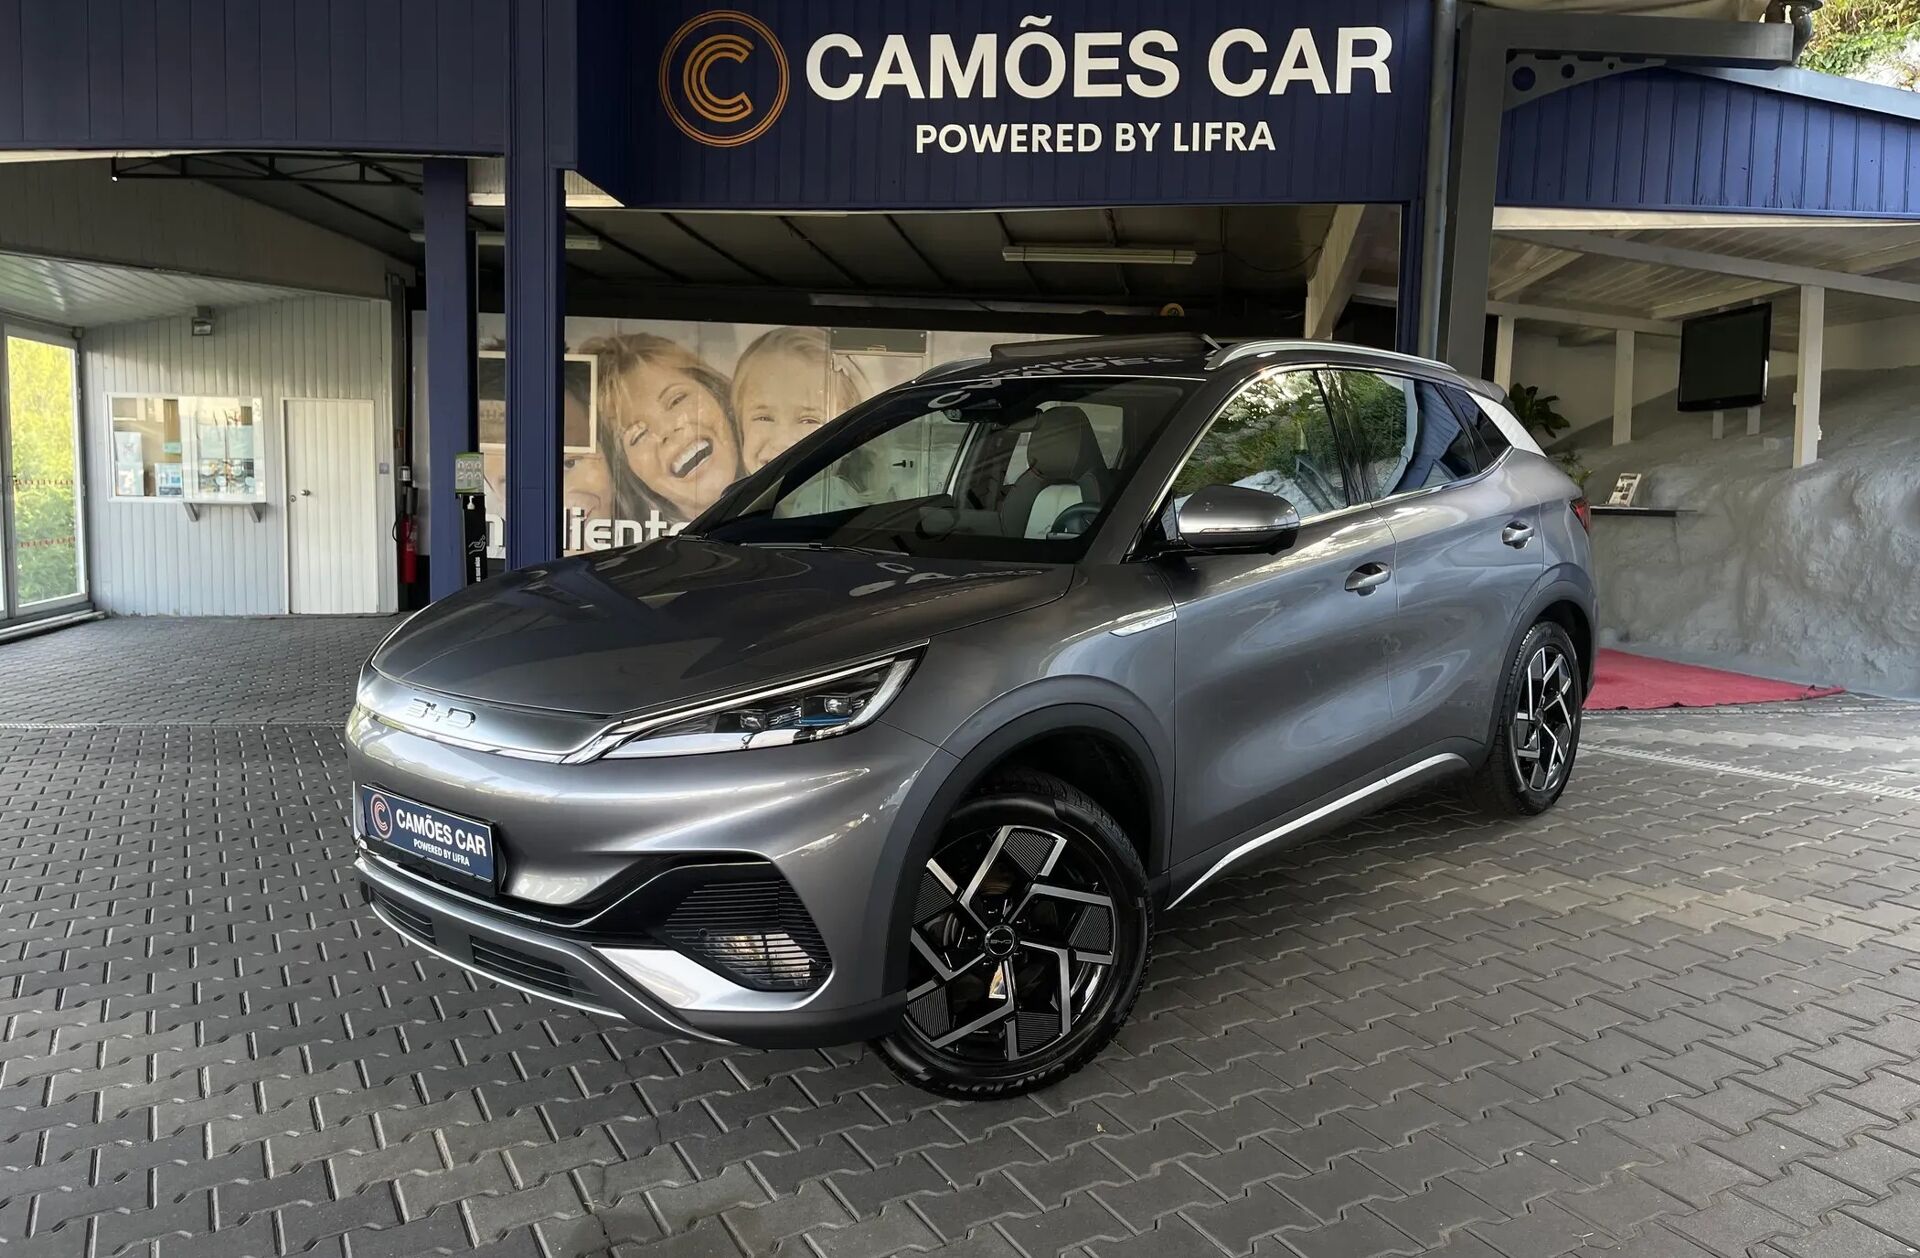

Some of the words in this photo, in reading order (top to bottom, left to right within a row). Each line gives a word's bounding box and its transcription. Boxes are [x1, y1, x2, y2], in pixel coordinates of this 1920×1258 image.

[806, 15, 1180, 101] CAMÕES
[1208, 26, 1393, 97] CAR
[916, 123, 1103, 154] POWERED
[1115, 122, 1162, 153] BY
[1173, 121, 1276, 152] LIFRA
[396, 808, 453, 846] CAMÕES
[455, 829, 487, 857] CAR
[413, 838, 443, 858] POWERED
[443, 848, 452, 860] BY
[452, 852, 471, 867] LIFRA
